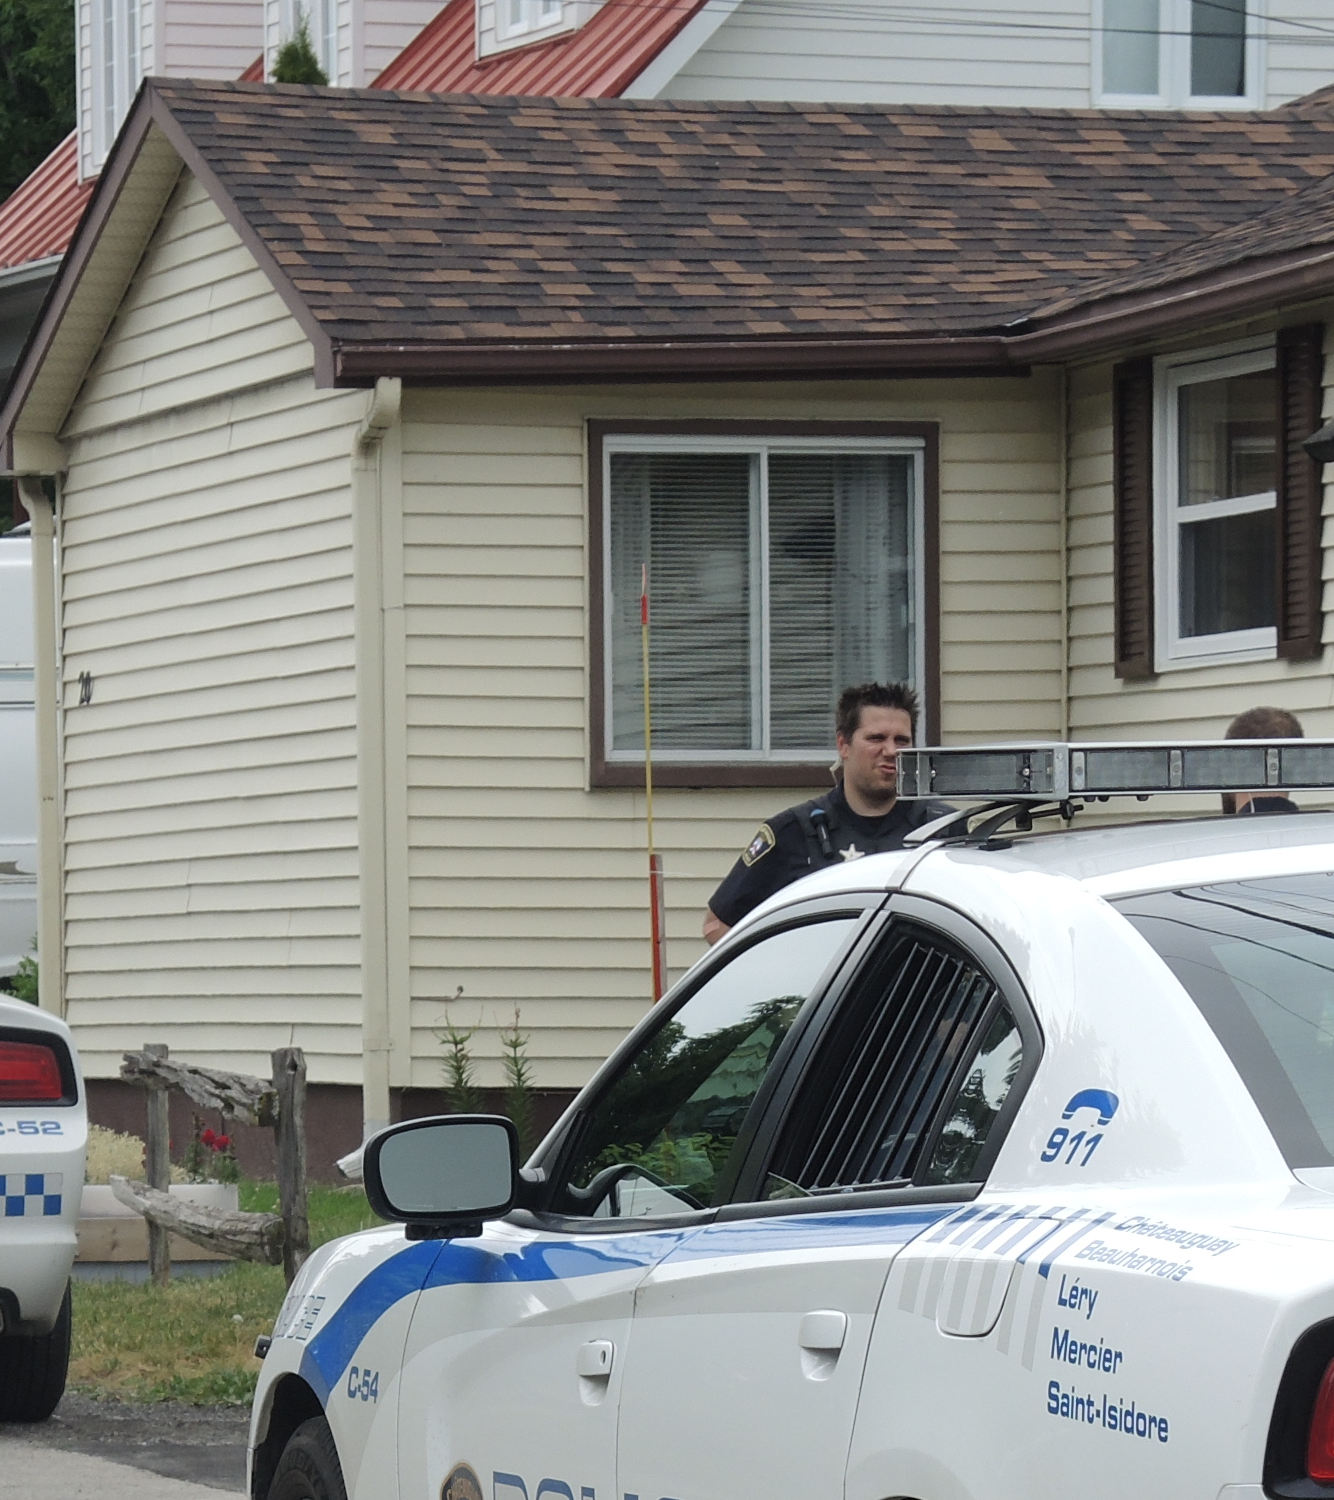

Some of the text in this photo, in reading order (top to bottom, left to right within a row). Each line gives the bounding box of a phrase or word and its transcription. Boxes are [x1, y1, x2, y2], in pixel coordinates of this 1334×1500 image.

[1040, 1126, 1104, 1167] 911
[1114, 1216, 1241, 1257] Châteauguay
[1074, 1239, 1194, 1282] Beauharnois
[1058, 1274, 1099, 1320] Léry
[1050, 1327, 1123, 1375] Mercier
[347, 1366, 379, 1404] C-54
[1047, 1380, 1169, 1443] Saint-Isidore
